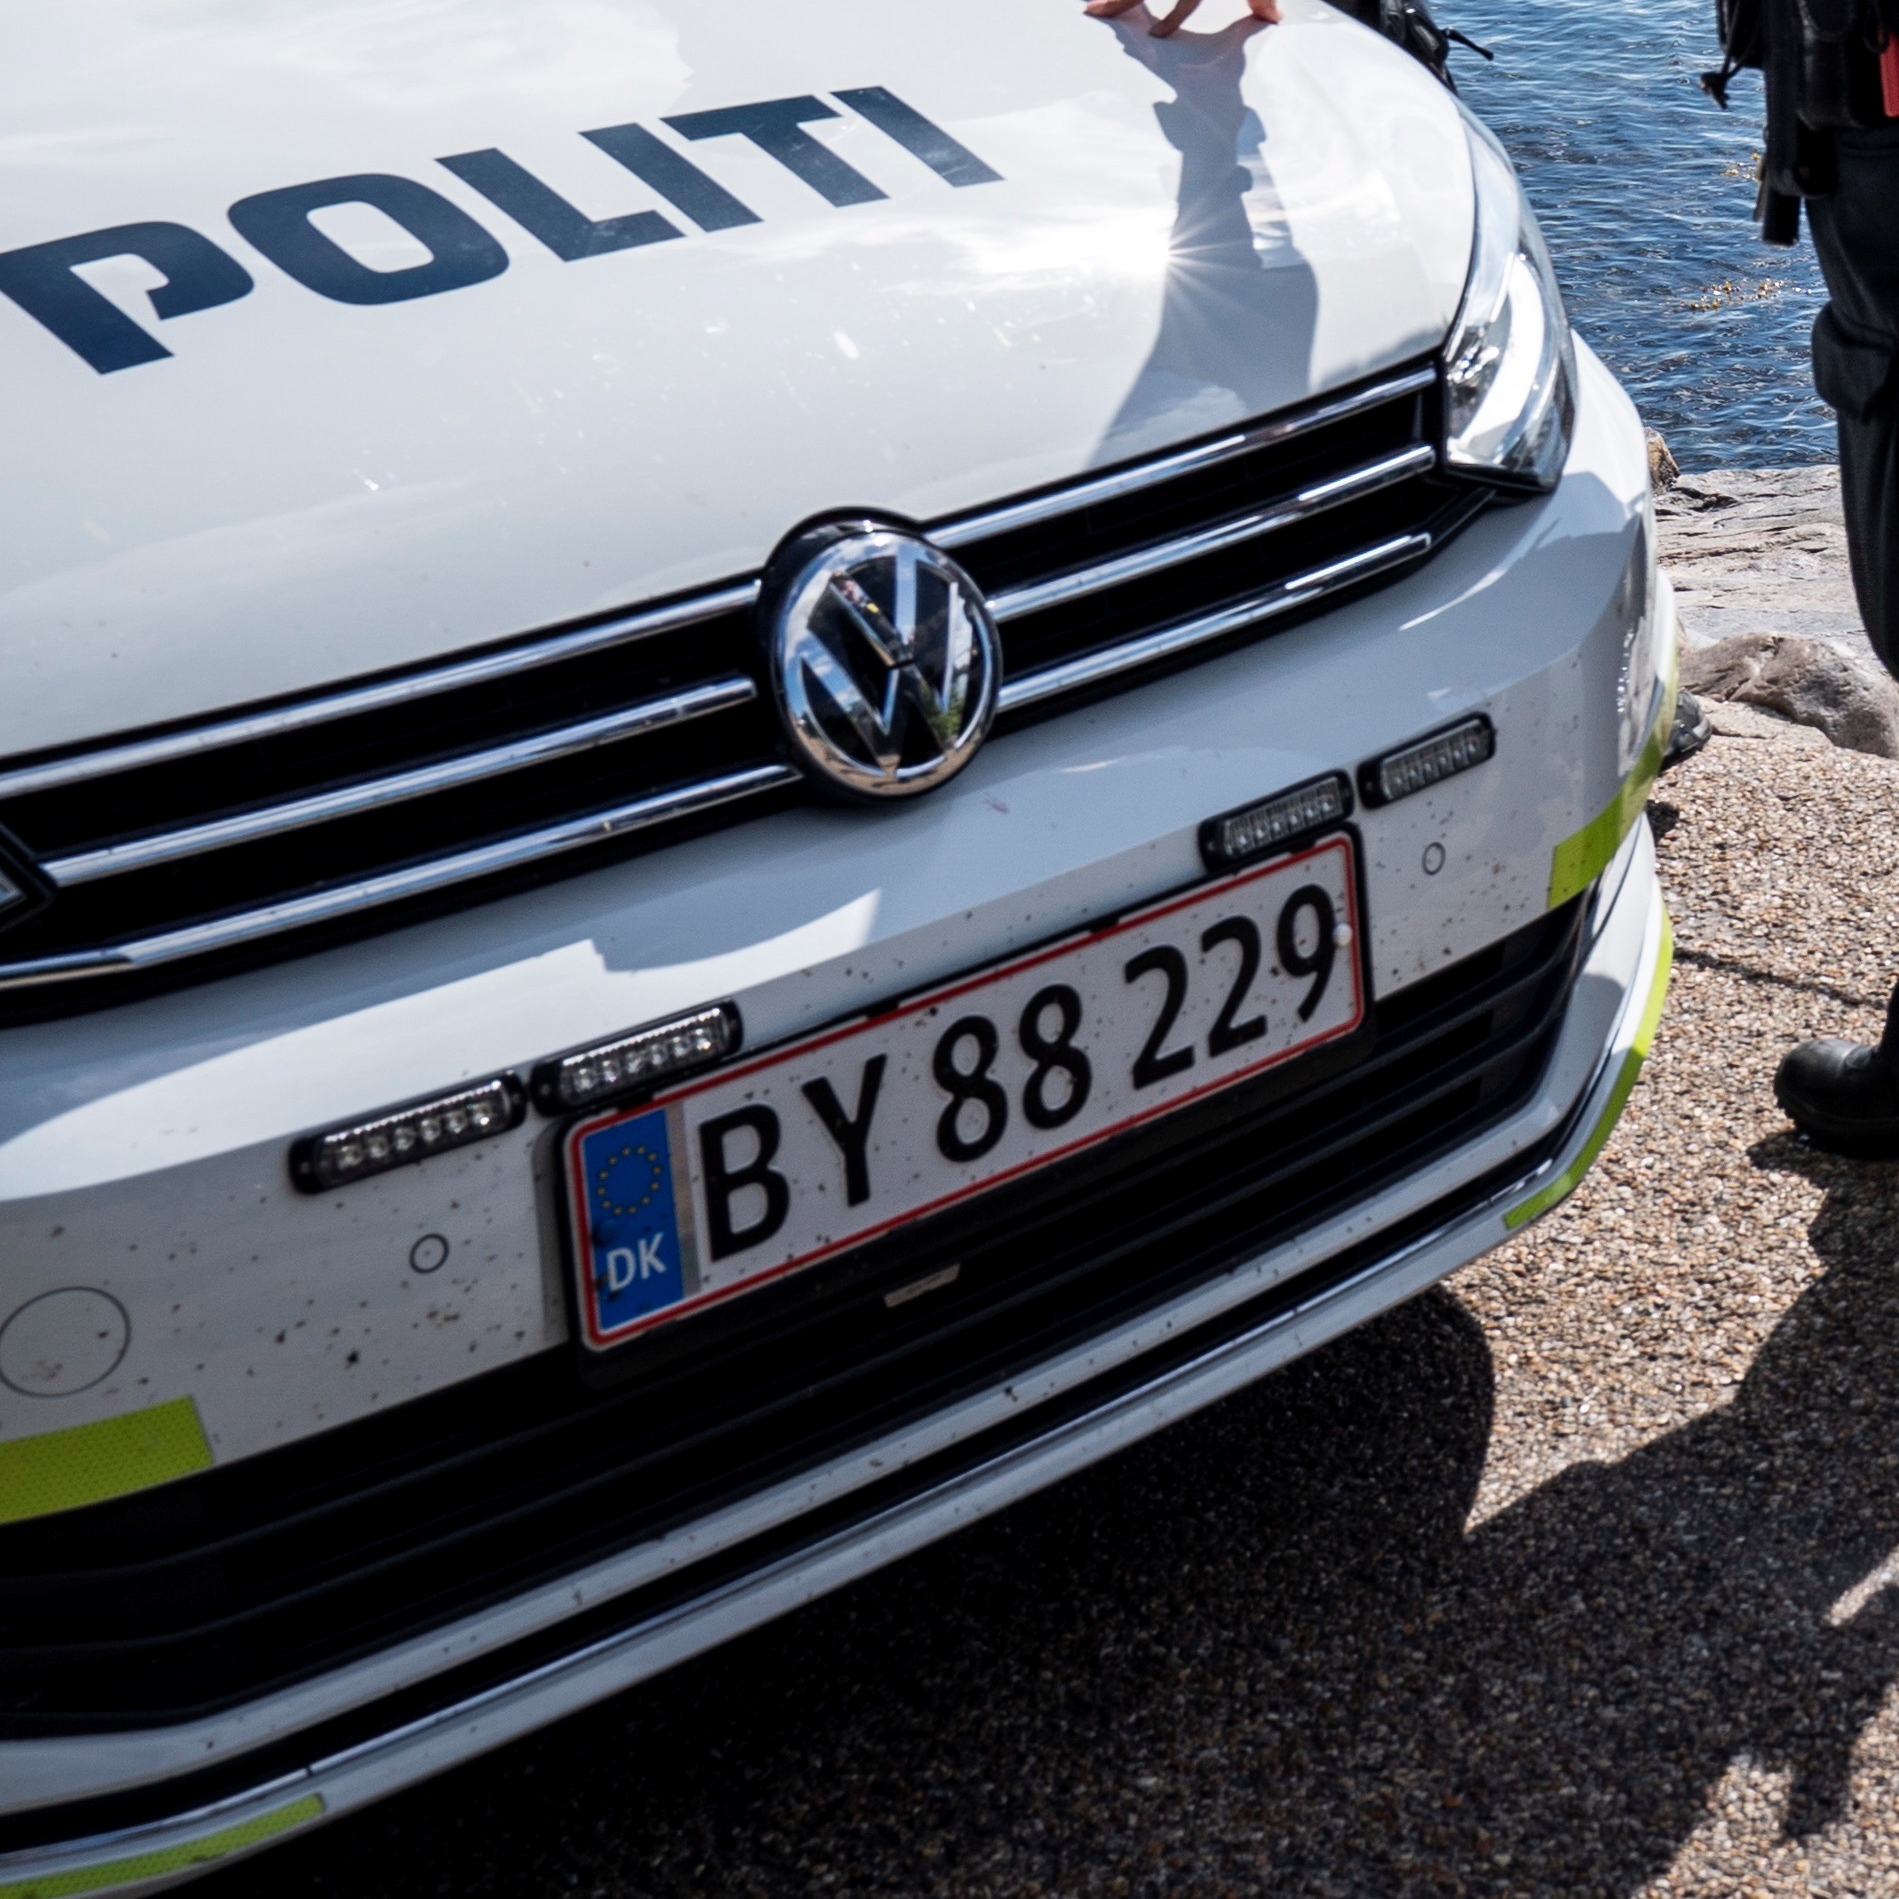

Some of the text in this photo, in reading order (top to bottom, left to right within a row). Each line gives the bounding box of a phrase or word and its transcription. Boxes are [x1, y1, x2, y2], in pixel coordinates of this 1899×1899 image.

[0, 85, 1006, 375] POLITI
[698, 883, 1338, 1262] BY 88 229
[605, 1231, 668, 1293] DK
